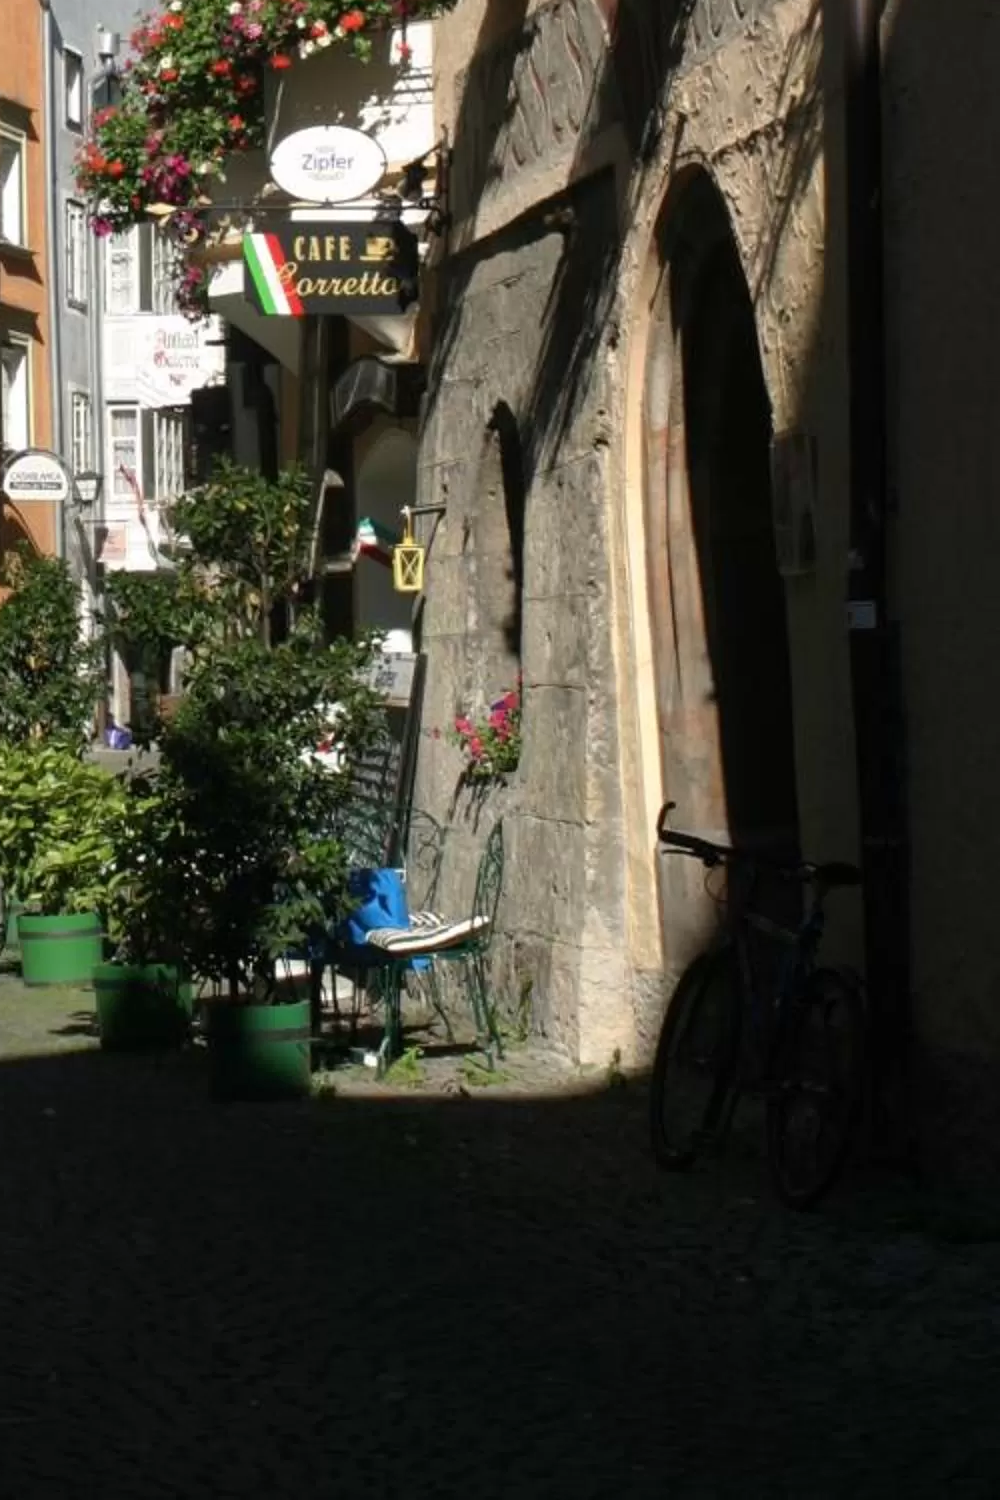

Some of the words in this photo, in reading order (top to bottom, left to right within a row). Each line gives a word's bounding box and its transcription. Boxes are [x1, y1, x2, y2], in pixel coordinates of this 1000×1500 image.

[301, 153, 355, 172] Zipfer
[294, 235, 351, 261] CAFE
[277, 261, 398, 297] Corretto
